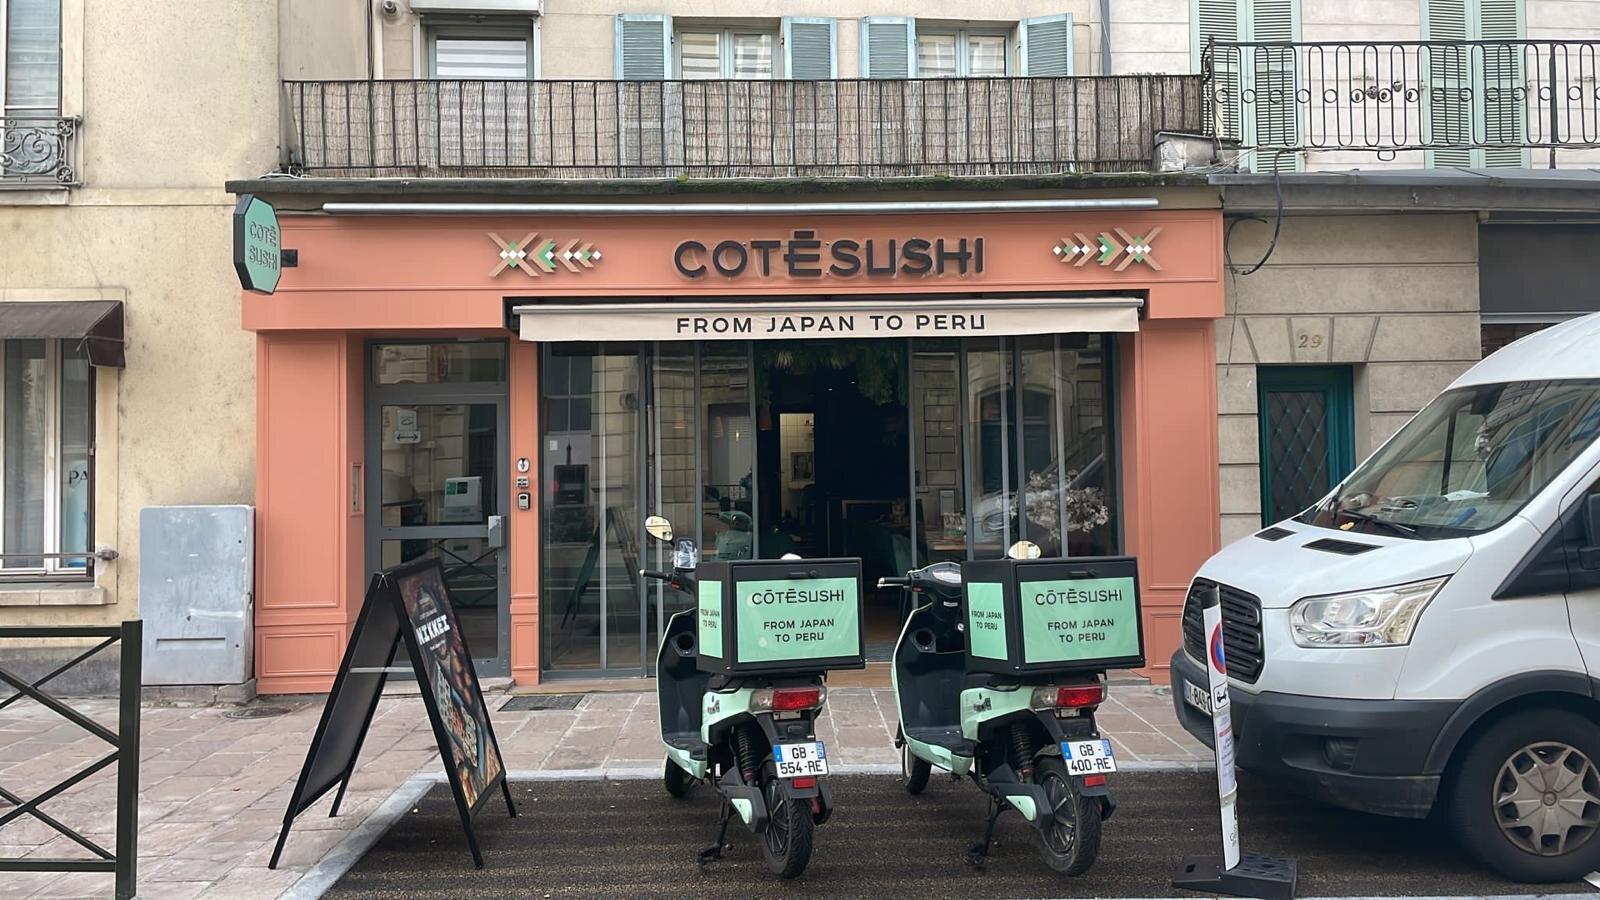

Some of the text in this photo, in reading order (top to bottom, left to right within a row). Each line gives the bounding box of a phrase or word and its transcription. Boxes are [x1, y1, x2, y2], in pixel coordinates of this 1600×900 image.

[249, 245, 278, 271] SUSHI
[676, 314, 985, 333] FROM JAPAN TO PERU
[1298, 334, 1321, 349] 29
[971, 610, 1002, 619] FROM JAPAN
[415, 614, 451, 646] NIKKEI
[763, 618, 834, 630] FROM JAPAN
[976, 621, 998, 630] TO PERU
[1047, 618, 1114, 631] FROM JAPAN
[775, 632, 824, 642] TO PERU
[1059, 632, 1105, 643] TO PERU
[780, 760, 823, 775] 554-RE
[1071, 757, 1111, 772] 400-RE
